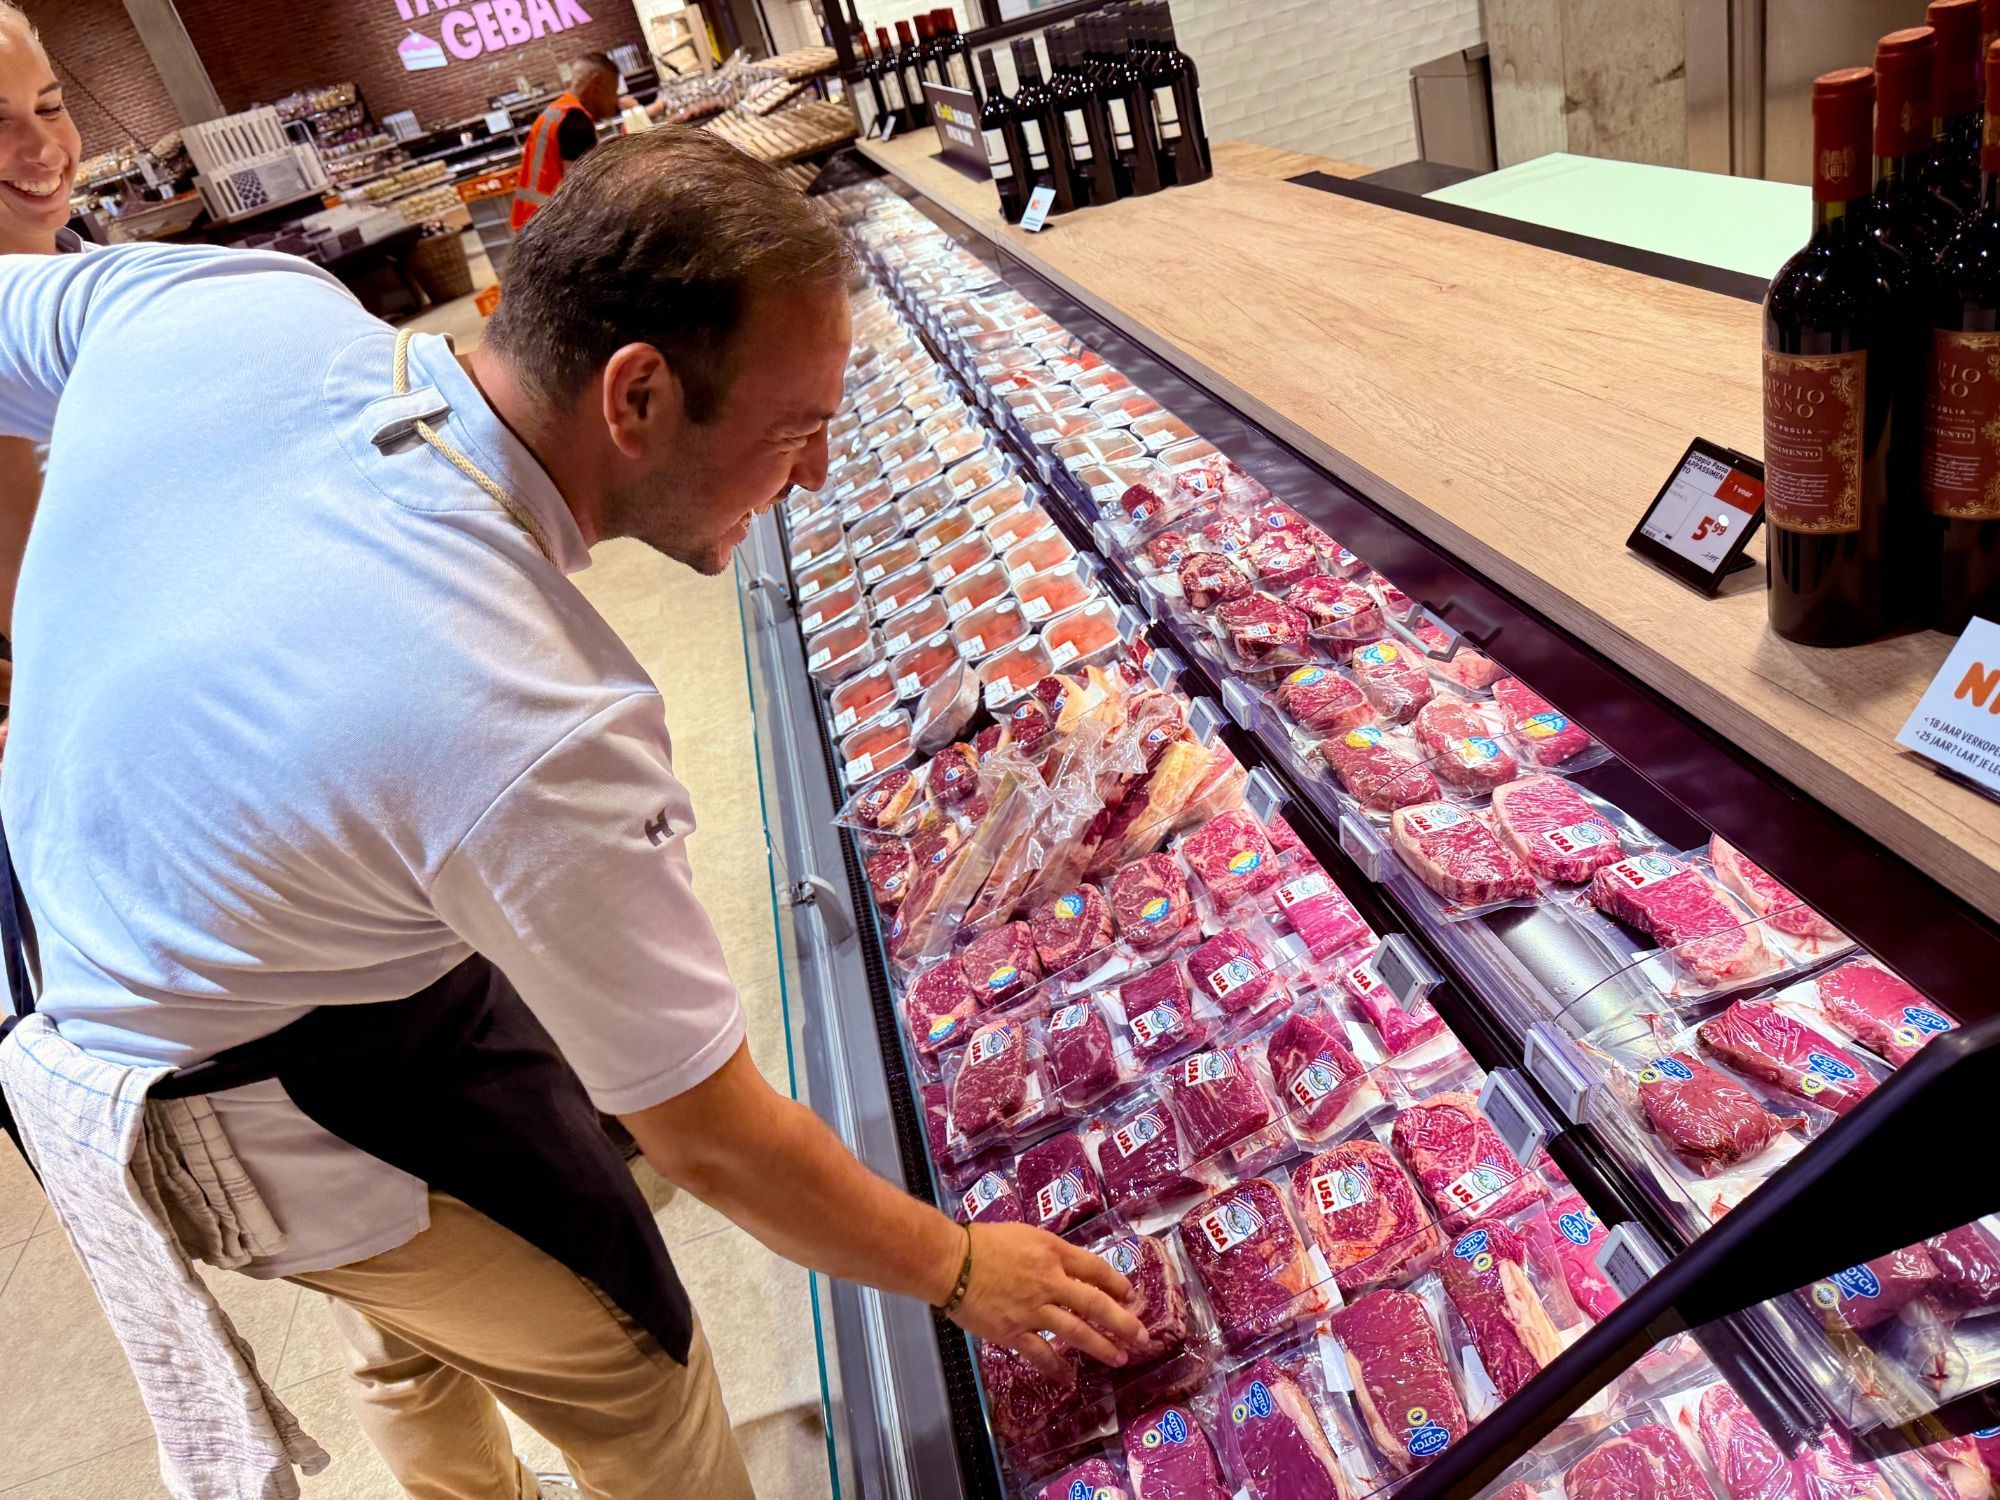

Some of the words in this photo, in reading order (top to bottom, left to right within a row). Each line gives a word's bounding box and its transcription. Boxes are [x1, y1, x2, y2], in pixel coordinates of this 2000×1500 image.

[441, 0, 592, 60] GEBAK
[1764, 375, 1825, 405] OPPIO
[1765, 392, 1814, 419] ASSO
[1779, 424, 1812, 435] PUGLIA
[1690, 452, 1712, 467] Doppio
[1711, 461, 1728, 474] Passo
[1737, 488, 1753, 498] voor
[1939, 721, 1962, 739] JAAR
[1929, 734, 1959, 755] JAAR?
[1956, 746, 1979, 766] LAAT
[1976, 756, 1990, 771] JE
[1549, 832, 1574, 852] USA
[1616, 864, 1645, 886] USA
[1213, 973, 1229, 993] USA
[1353, 969, 1371, 990] USA
[1134, 1018, 1151, 1040] USA
[1905, 1009, 1949, 1030] SCOTCH
[1188, 1059, 1198, 1083] USA
[1810, 1054, 1852, 1078] SCOTCH
[1117, 1130, 1133, 1153] USA
[965, 1191, 978, 1215] USA
[1040, 1189, 1053, 1217] USA
[1317, 1179, 1334, 1210] USA
[1206, 1216, 1228, 1249] USA
[1560, 1216, 1588, 1242] SCOTCH
[1455, 1231, 1485, 1255] SCOTCH
[1846, 1266, 1877, 1295] OTCH
[1253, 1384, 1268, 1415] SCOTCH
[1166, 1412, 1184, 1441] SCOTCH
[1411, 1430, 1447, 1453] SCOTCH
